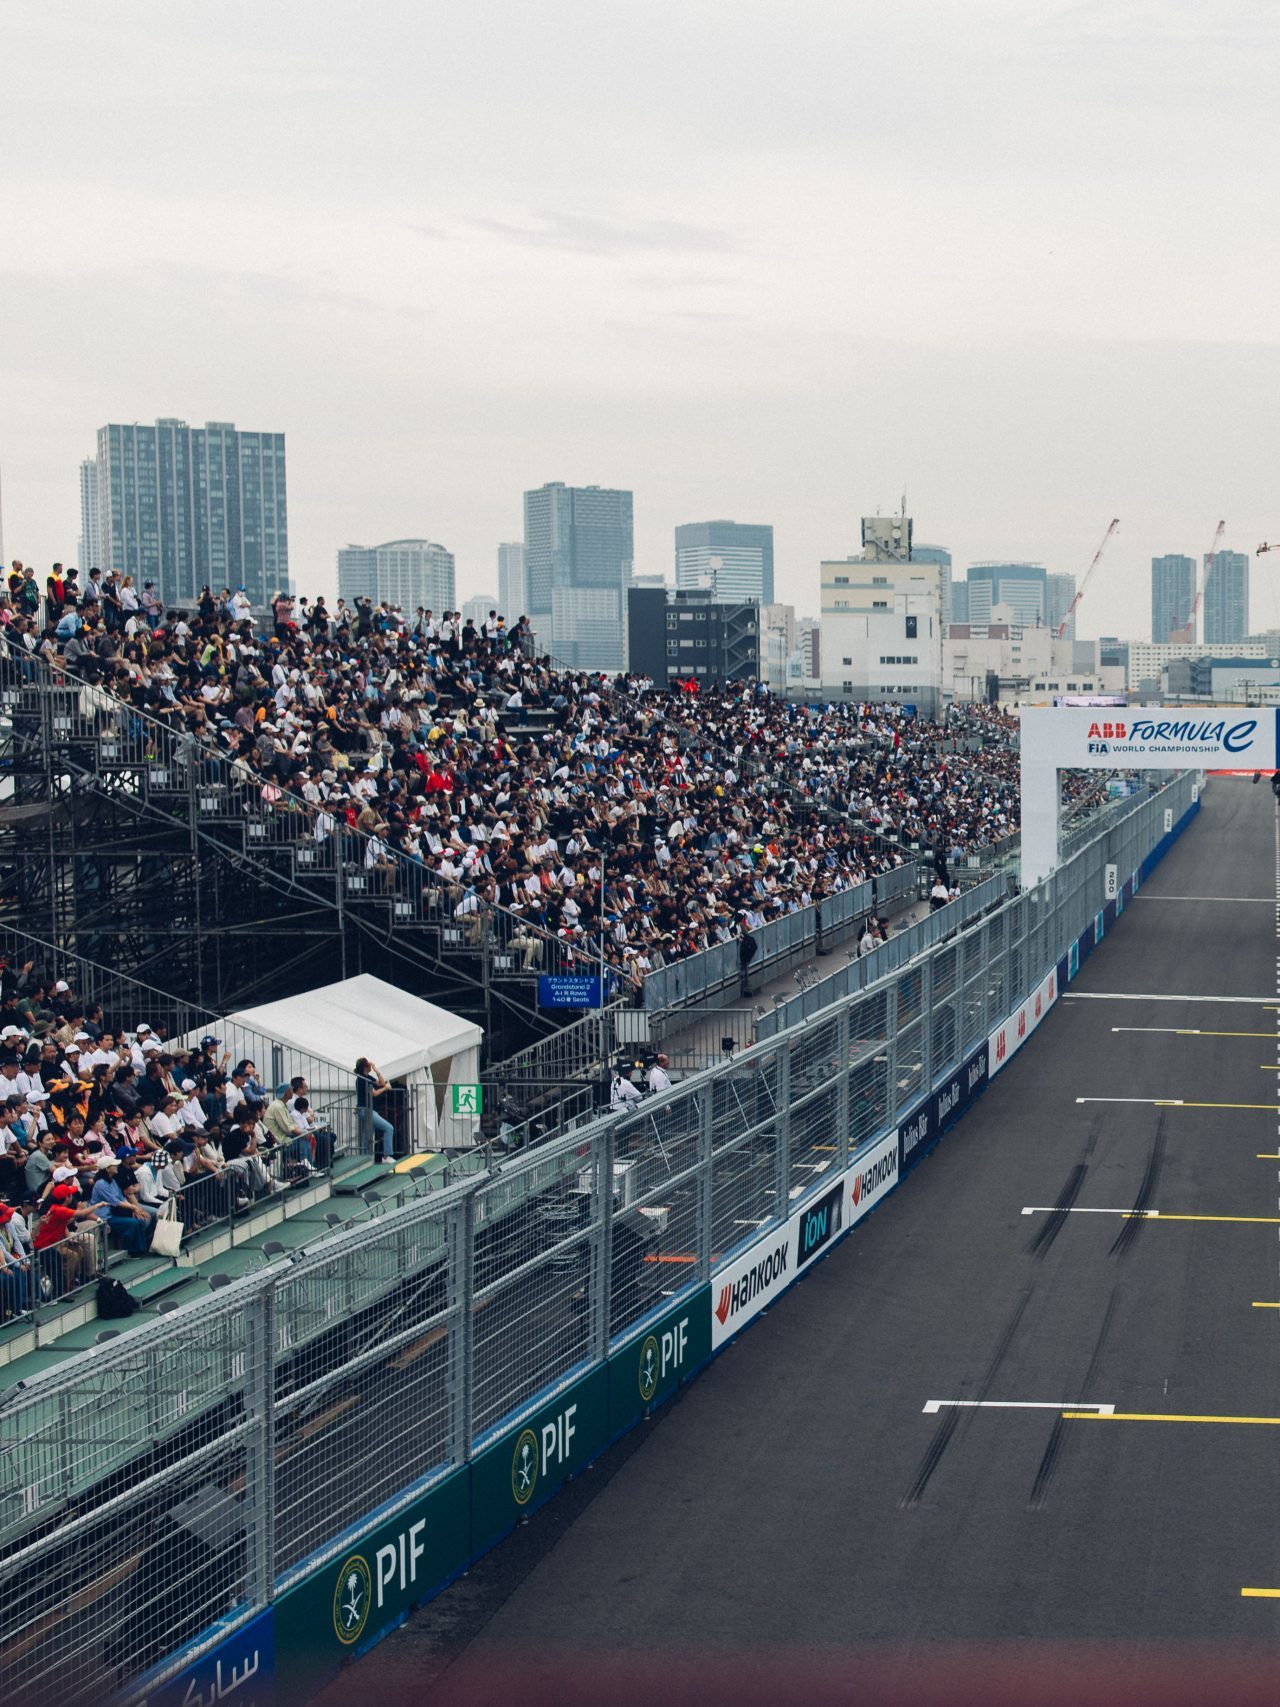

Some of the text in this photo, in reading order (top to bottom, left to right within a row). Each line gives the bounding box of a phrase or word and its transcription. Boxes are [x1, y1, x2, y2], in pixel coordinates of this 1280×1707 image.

[1088, 723, 1126, 738] ABB
[1129, 720, 1226, 741] FORMULA
[996, 1030, 1006, 1064] ABB
[904, 1125, 918, 1162] Julius
[661, 1316, 689, 1378] PIF
[542, 1403, 577, 1477] PIF
[376, 1517, 426, 1607] PIF
